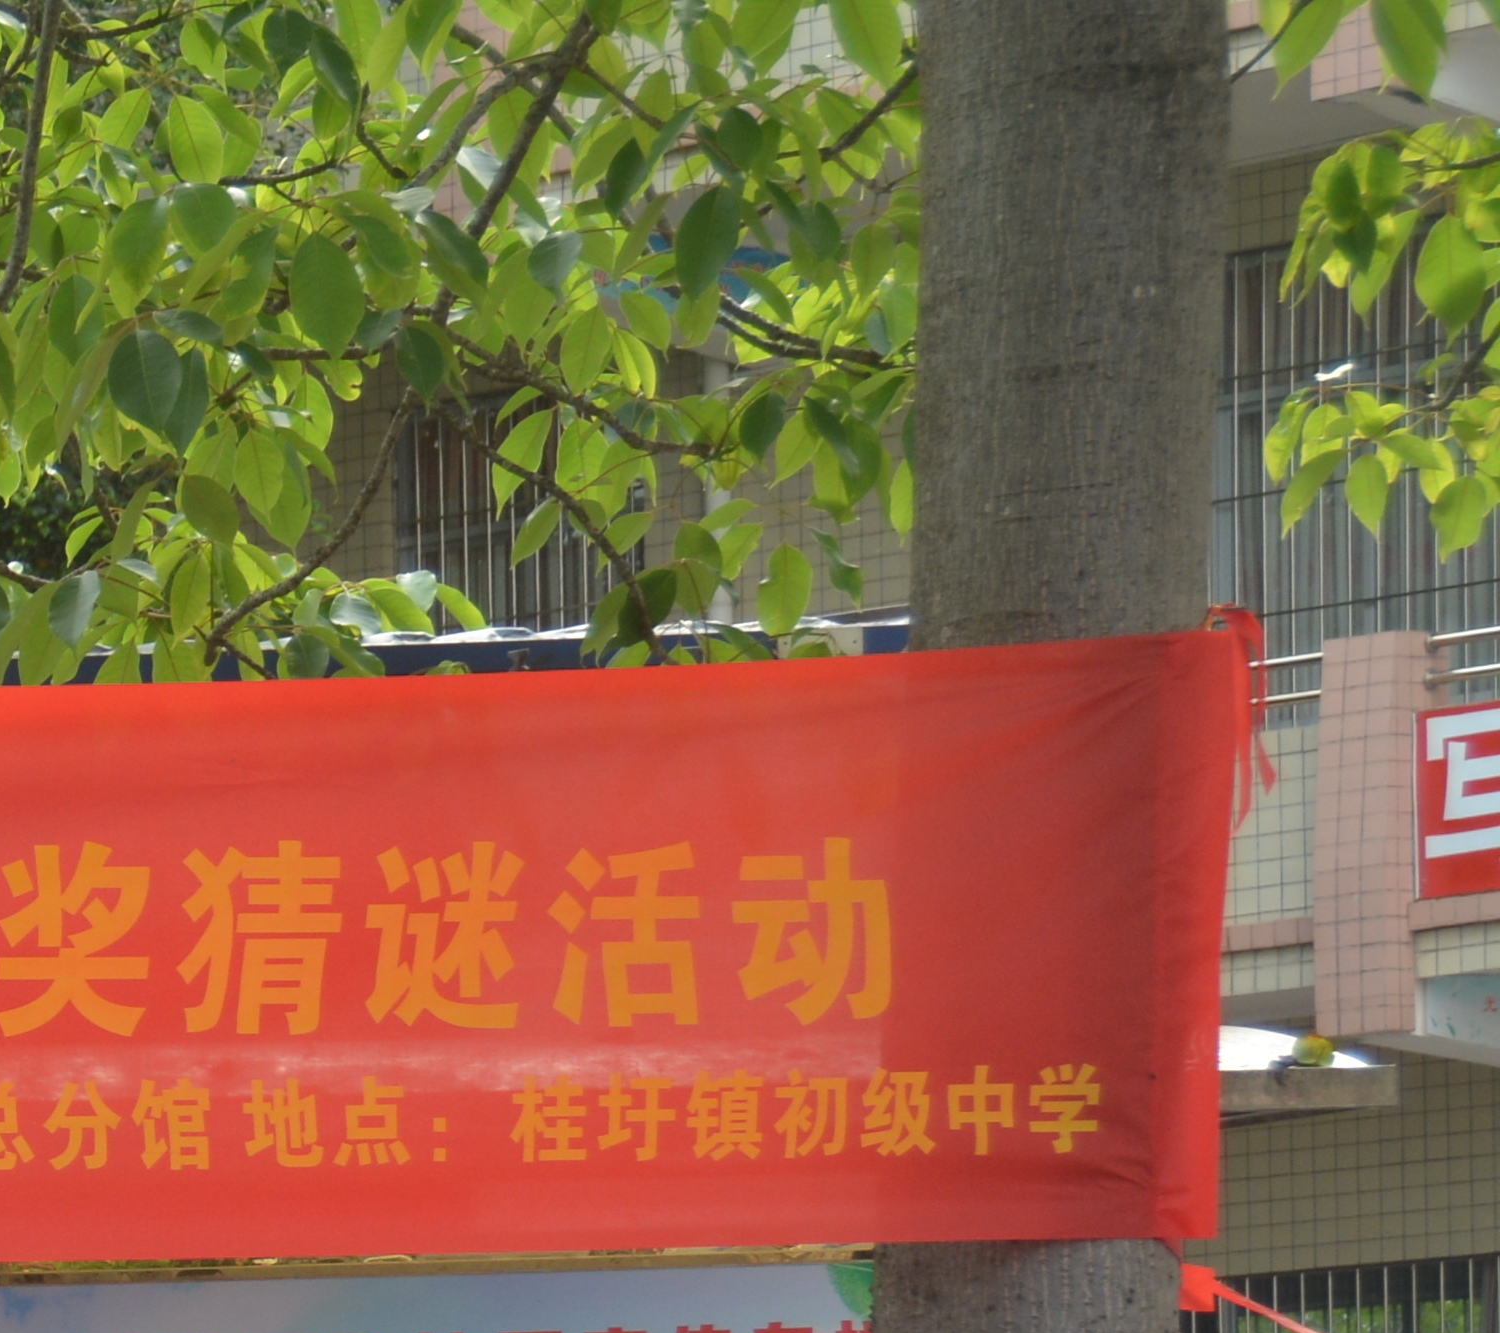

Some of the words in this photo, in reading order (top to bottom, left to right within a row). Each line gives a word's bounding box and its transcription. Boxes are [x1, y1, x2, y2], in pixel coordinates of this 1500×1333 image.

[243, 1064, 1103, 1169] 地点：桂圩镇初级中学
